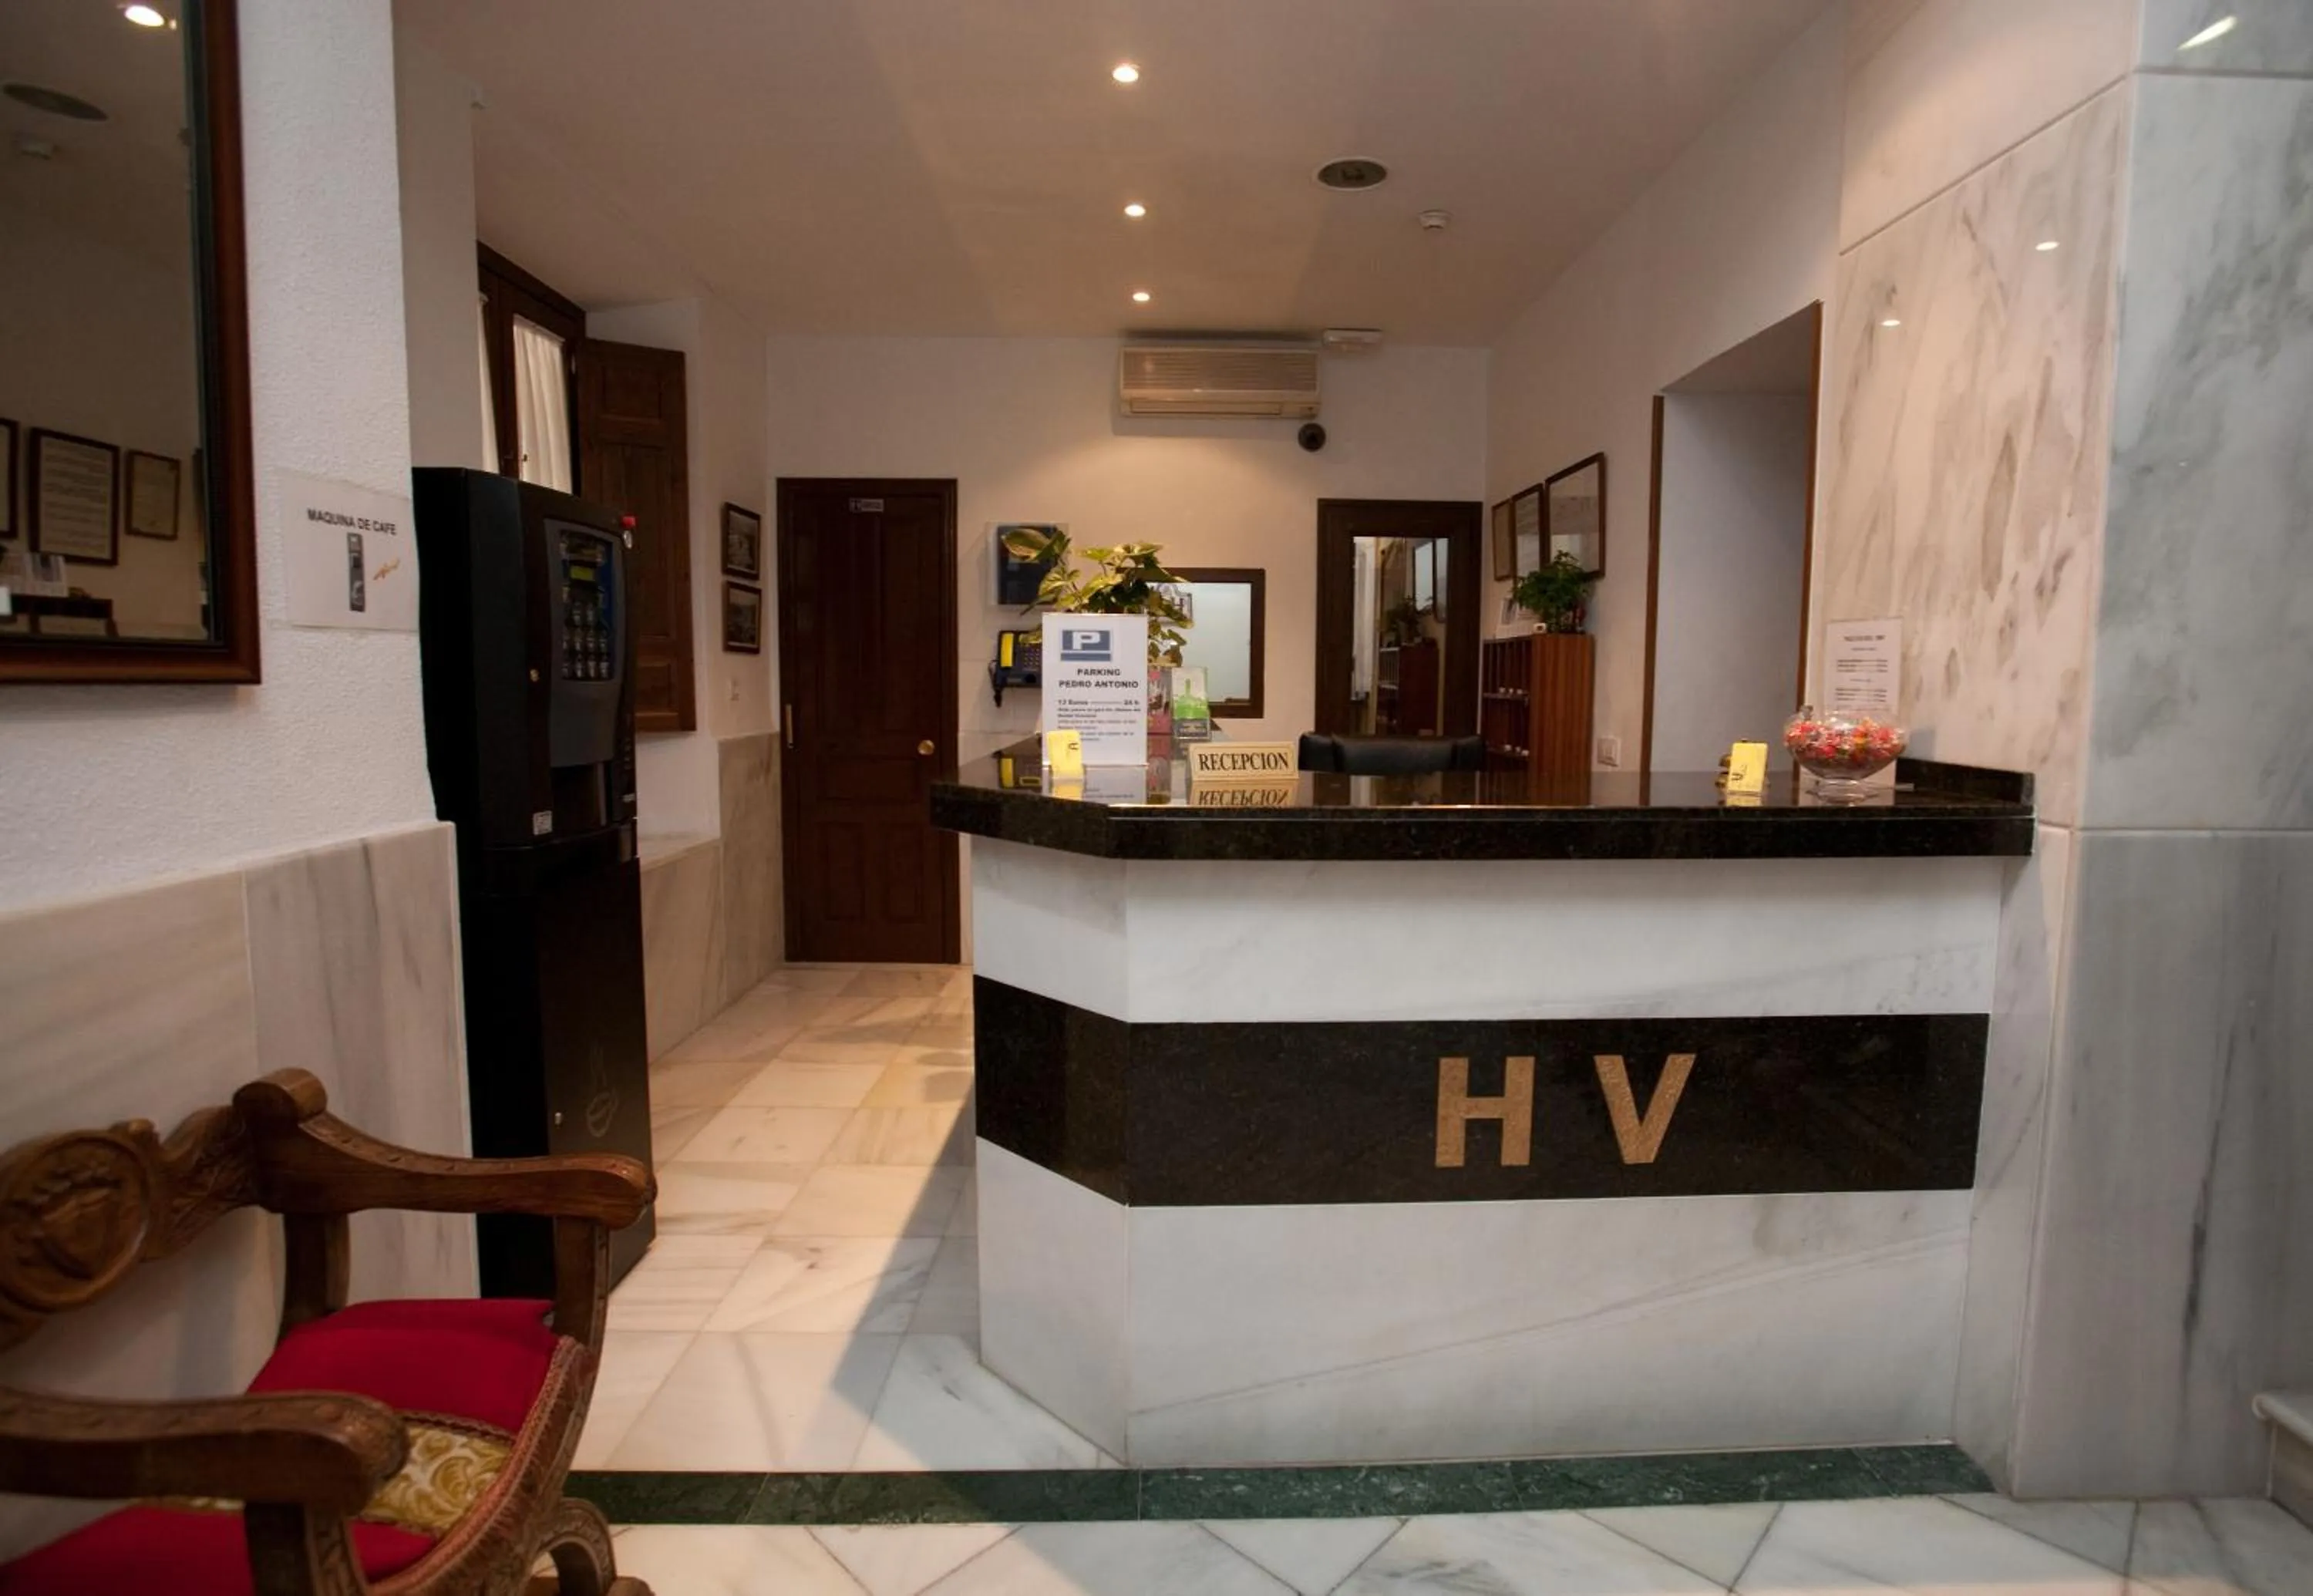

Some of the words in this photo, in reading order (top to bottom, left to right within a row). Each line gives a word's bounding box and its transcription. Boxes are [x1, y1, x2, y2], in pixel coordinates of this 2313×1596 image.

[358, 517, 371, 531] DE
[372, 520, 396, 536] CAFE
[1072, 631, 1100, 649] P
[1197, 753, 1290, 771] RECEPCION
[1435, 1056, 1535, 1167] H
[1594, 1053, 1695, 1164] V
